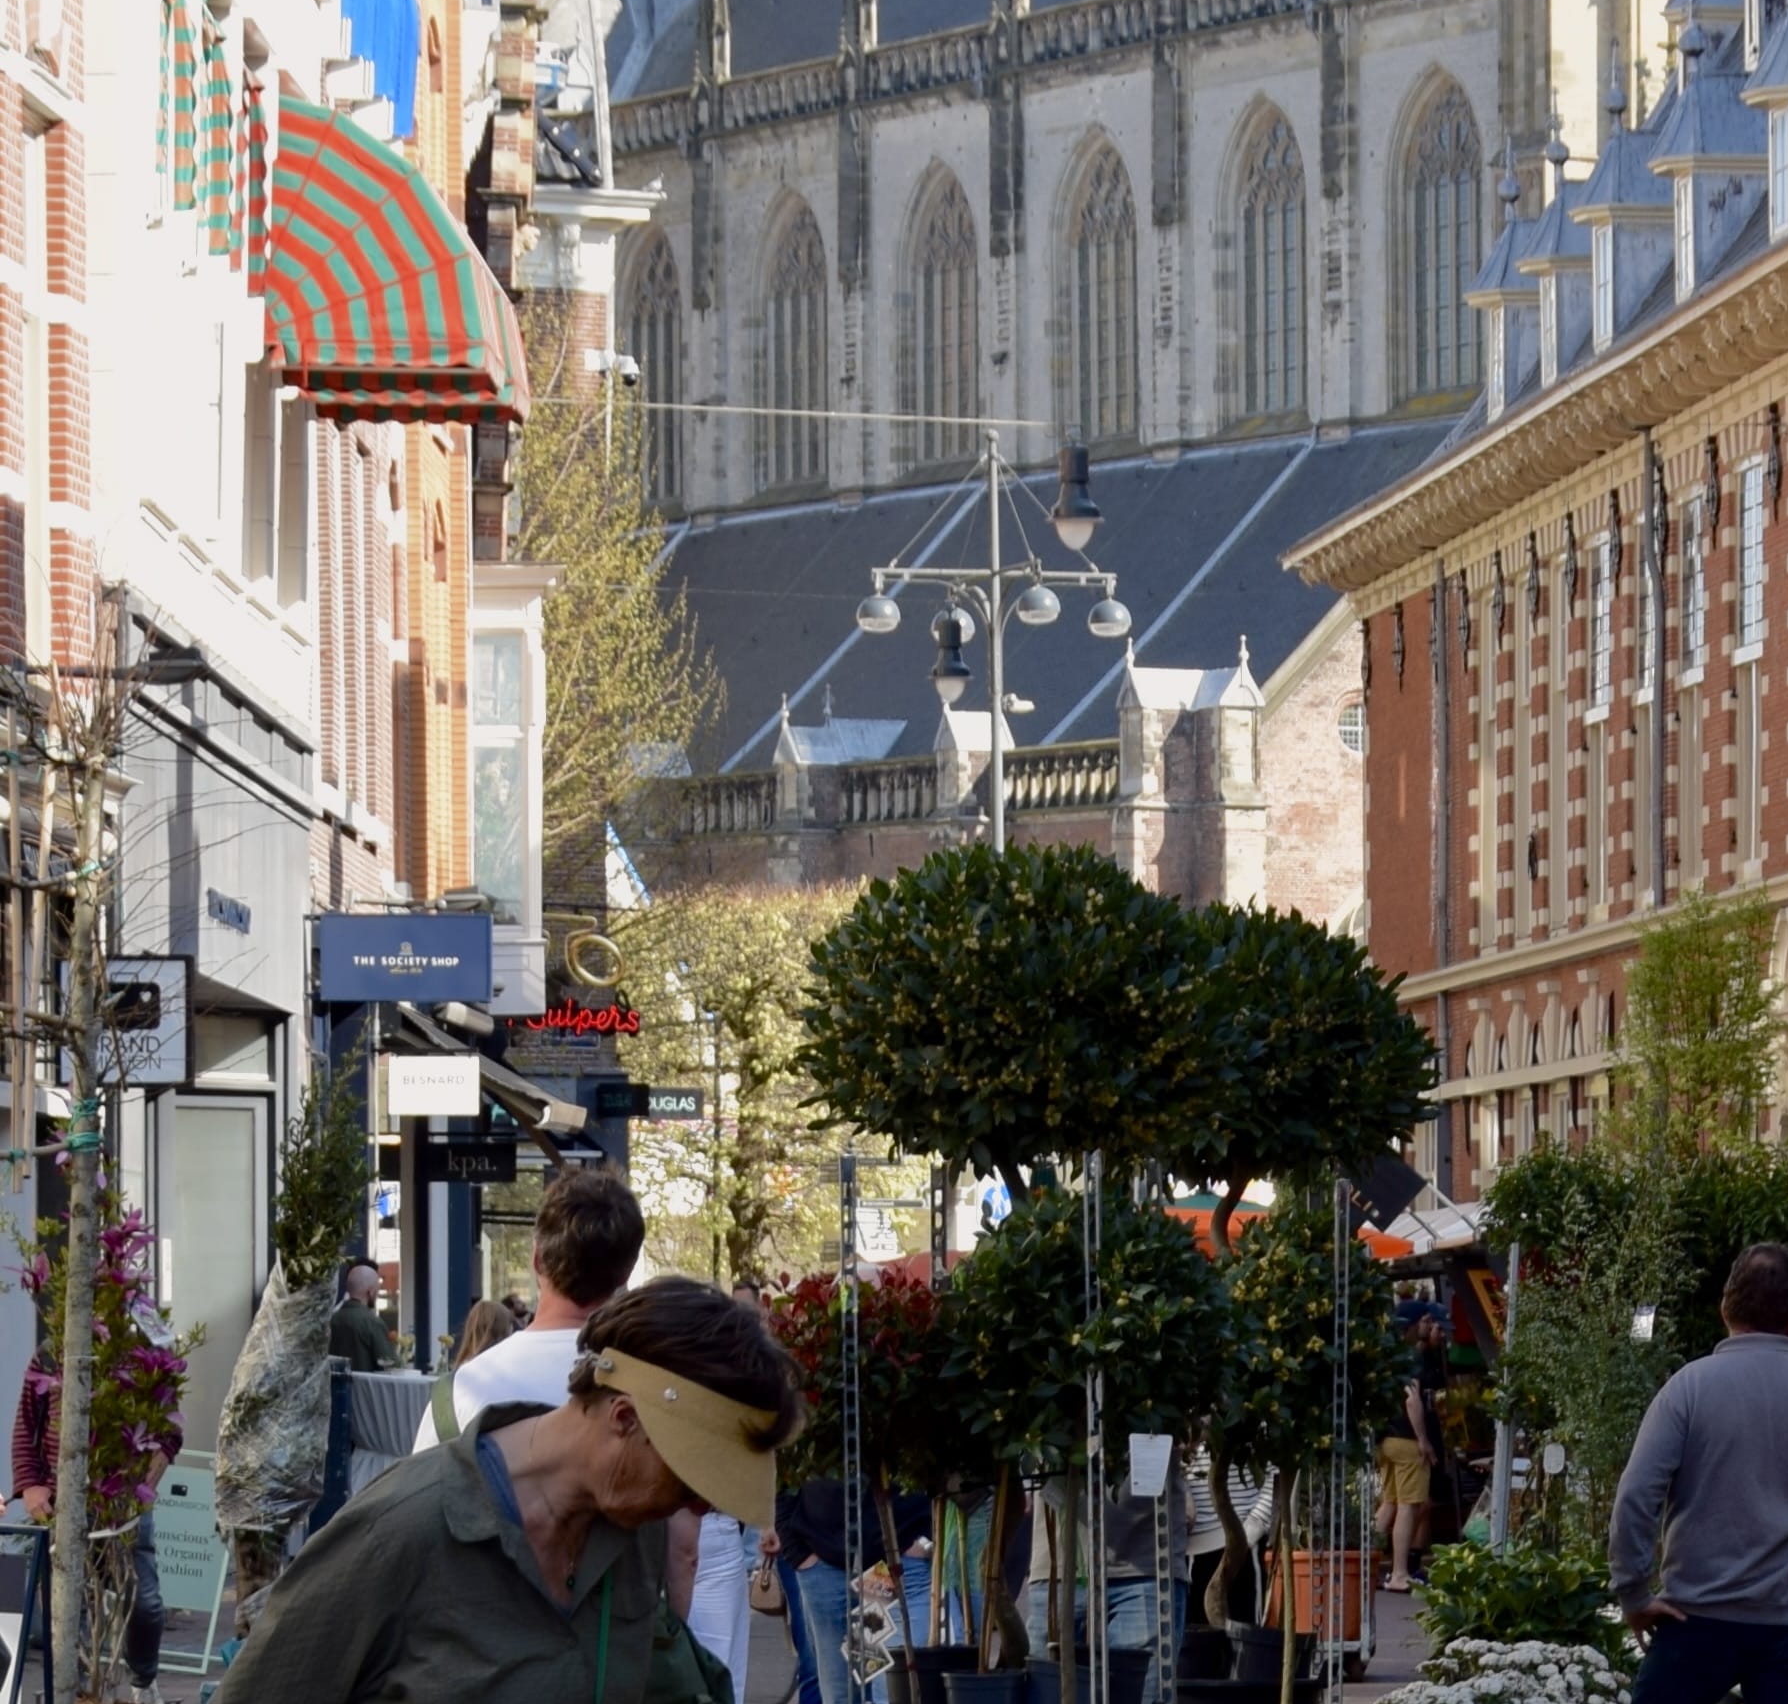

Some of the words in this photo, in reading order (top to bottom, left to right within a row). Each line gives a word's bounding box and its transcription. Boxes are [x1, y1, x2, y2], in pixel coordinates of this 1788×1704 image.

[353, 956, 375, 966] THE
[381, 956, 428, 966] SOCIETY
[431, 957, 460, 967] SHOP
[100, 1036, 161, 1054] RAND
[403, 1076, 465, 1085] BESNARD
[447, 1149, 498, 1178] kpa.
[164, 1547, 214, 1562] Organic
